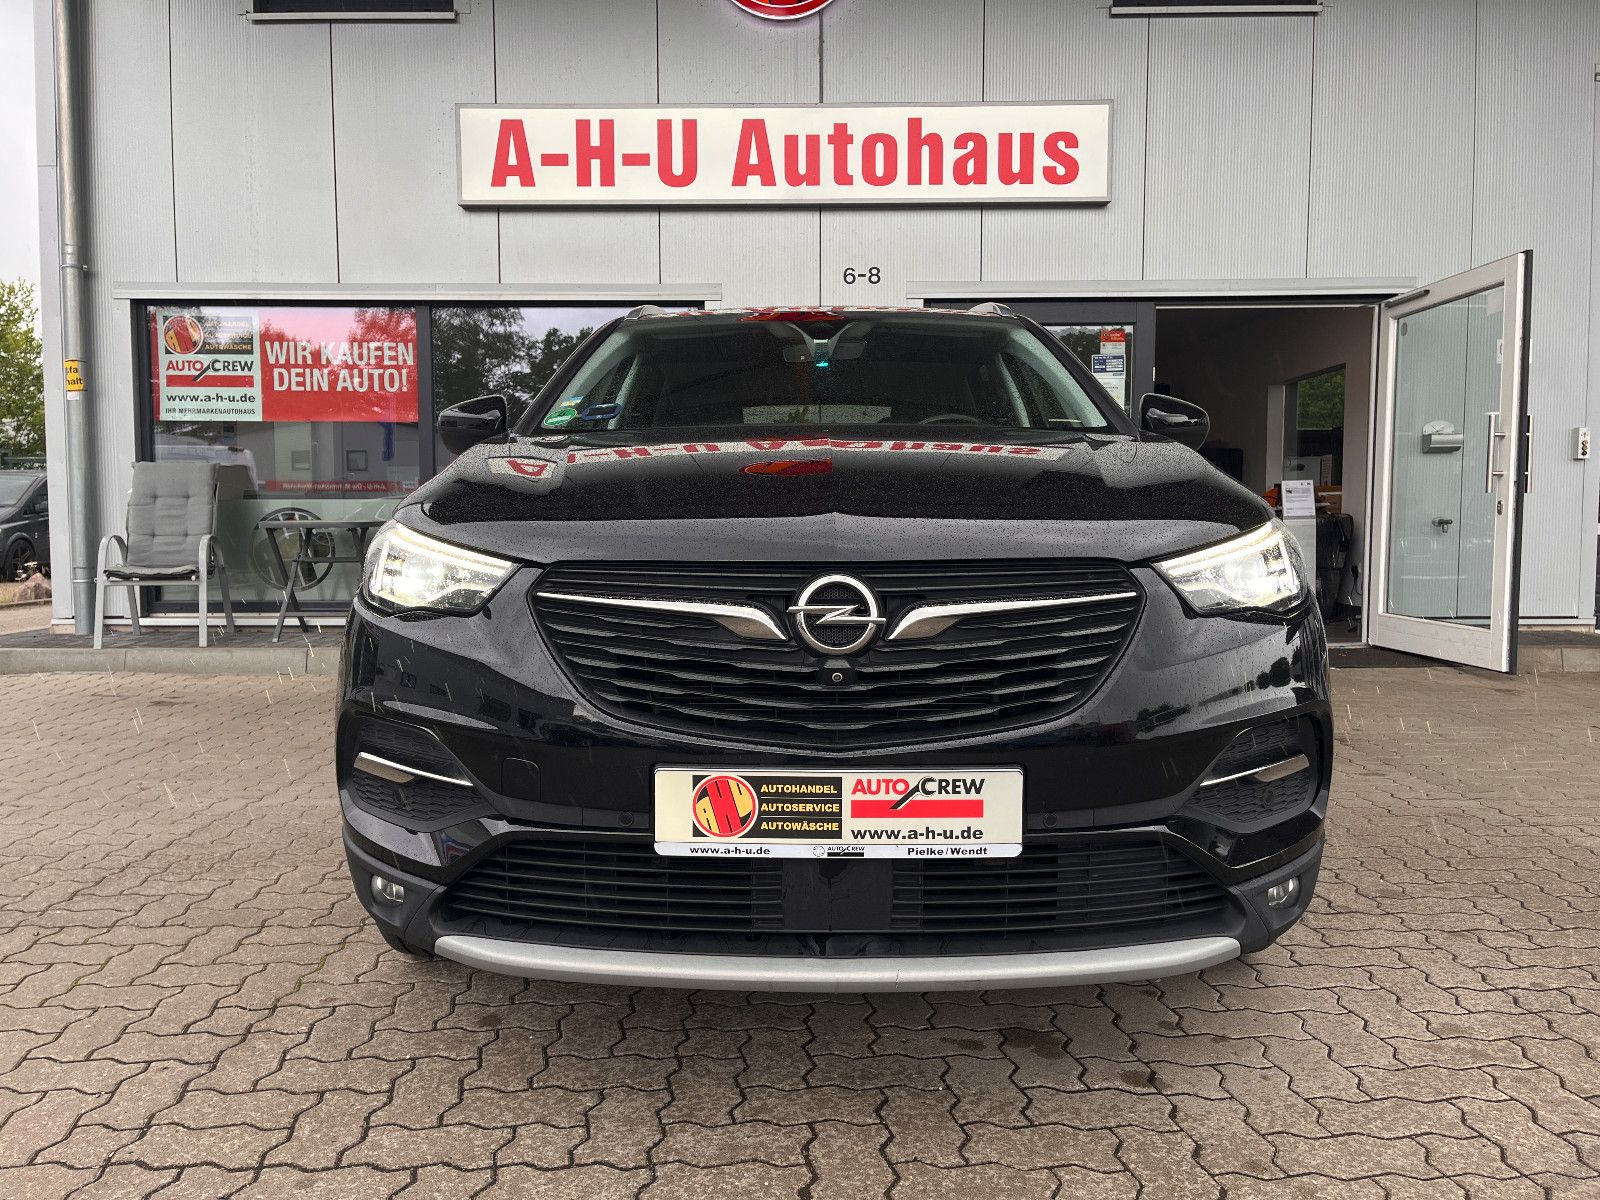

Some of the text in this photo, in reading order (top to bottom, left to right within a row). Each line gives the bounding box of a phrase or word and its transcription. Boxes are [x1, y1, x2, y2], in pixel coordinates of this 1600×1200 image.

[491, 117, 1080, 188] A-H-U Autohaus
[843, 266, 881, 285] 6-8
[265, 341, 414, 366] WIR KAUFEN
[273, 368, 408, 393] DEIN AUTO!
[166, 393, 256, 403] www.a-h-u.de
[165, 407, 256, 415] IHR MEHRMARKENAUTOHAUS
[760, 784, 838, 794] AUTOHANDEL
[760, 803, 840, 813] AUTOSERVICE
[760, 820, 840, 831] AUTOWÄSCHE
[851, 826, 984, 840] www.a-h-u.de
[690, 846, 771, 856] www.a-h-u.de
